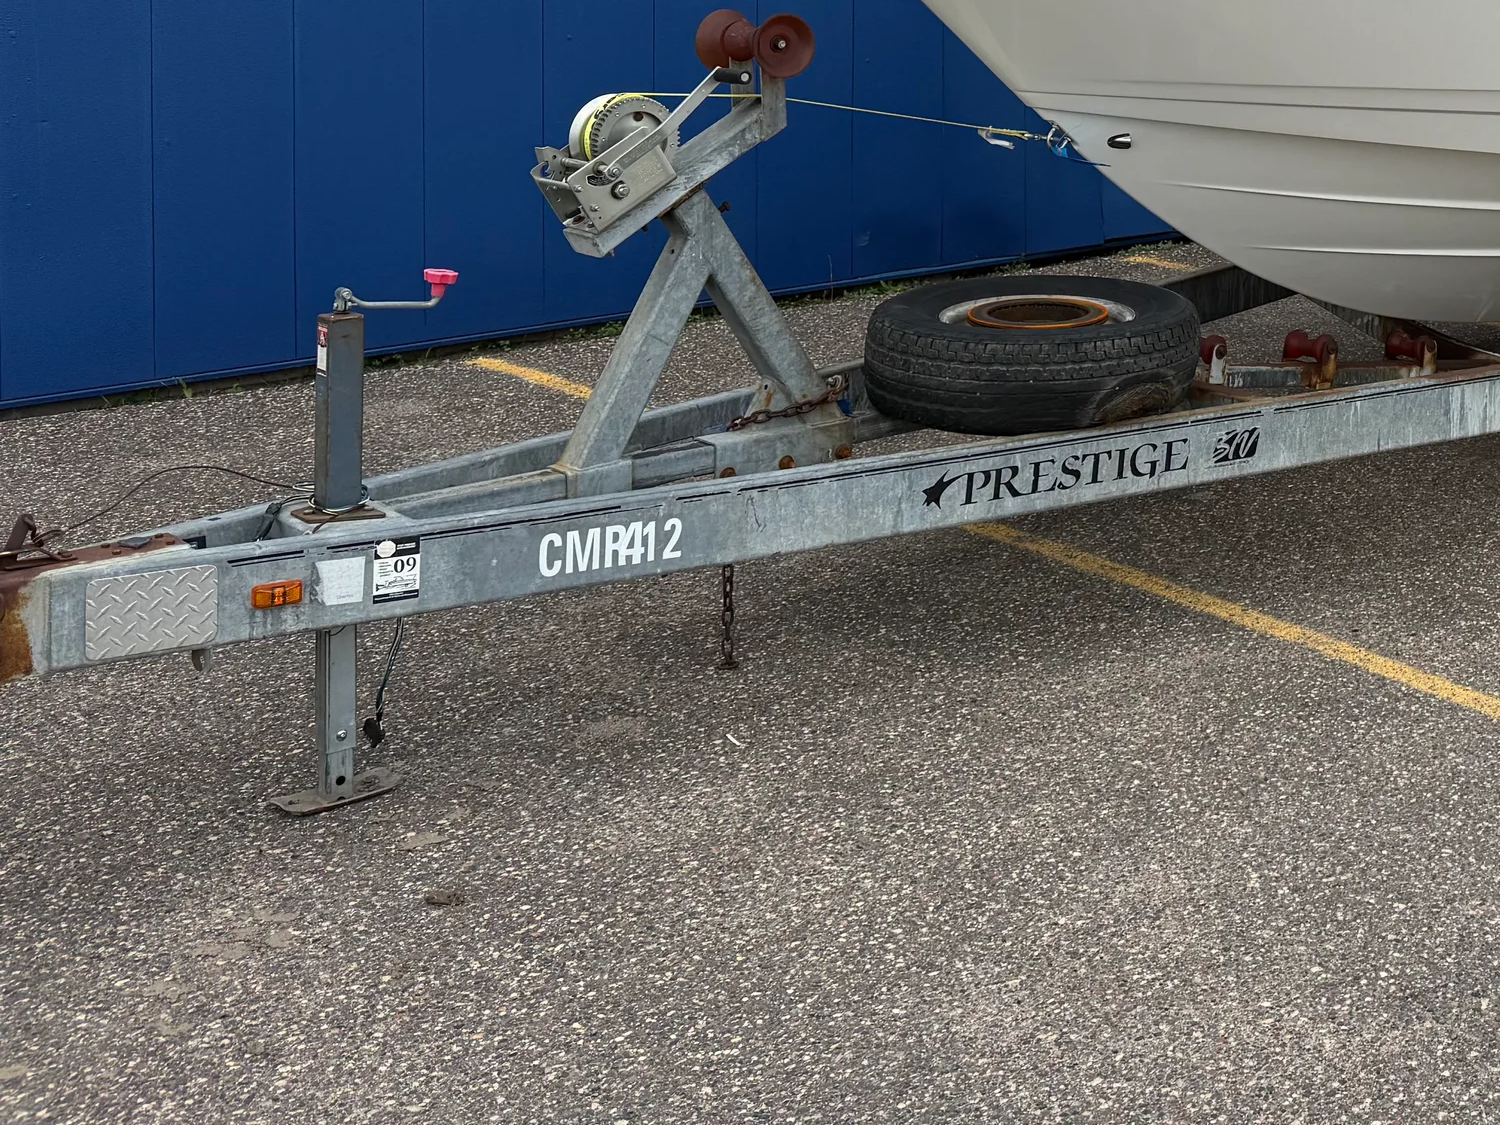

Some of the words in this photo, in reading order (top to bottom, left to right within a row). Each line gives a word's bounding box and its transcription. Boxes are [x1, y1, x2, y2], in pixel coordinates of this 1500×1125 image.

[960, 438, 1189, 506] PRESTIGE
[393, 556, 416, 573] 09
[539, 518, 683, 577] CMR412
